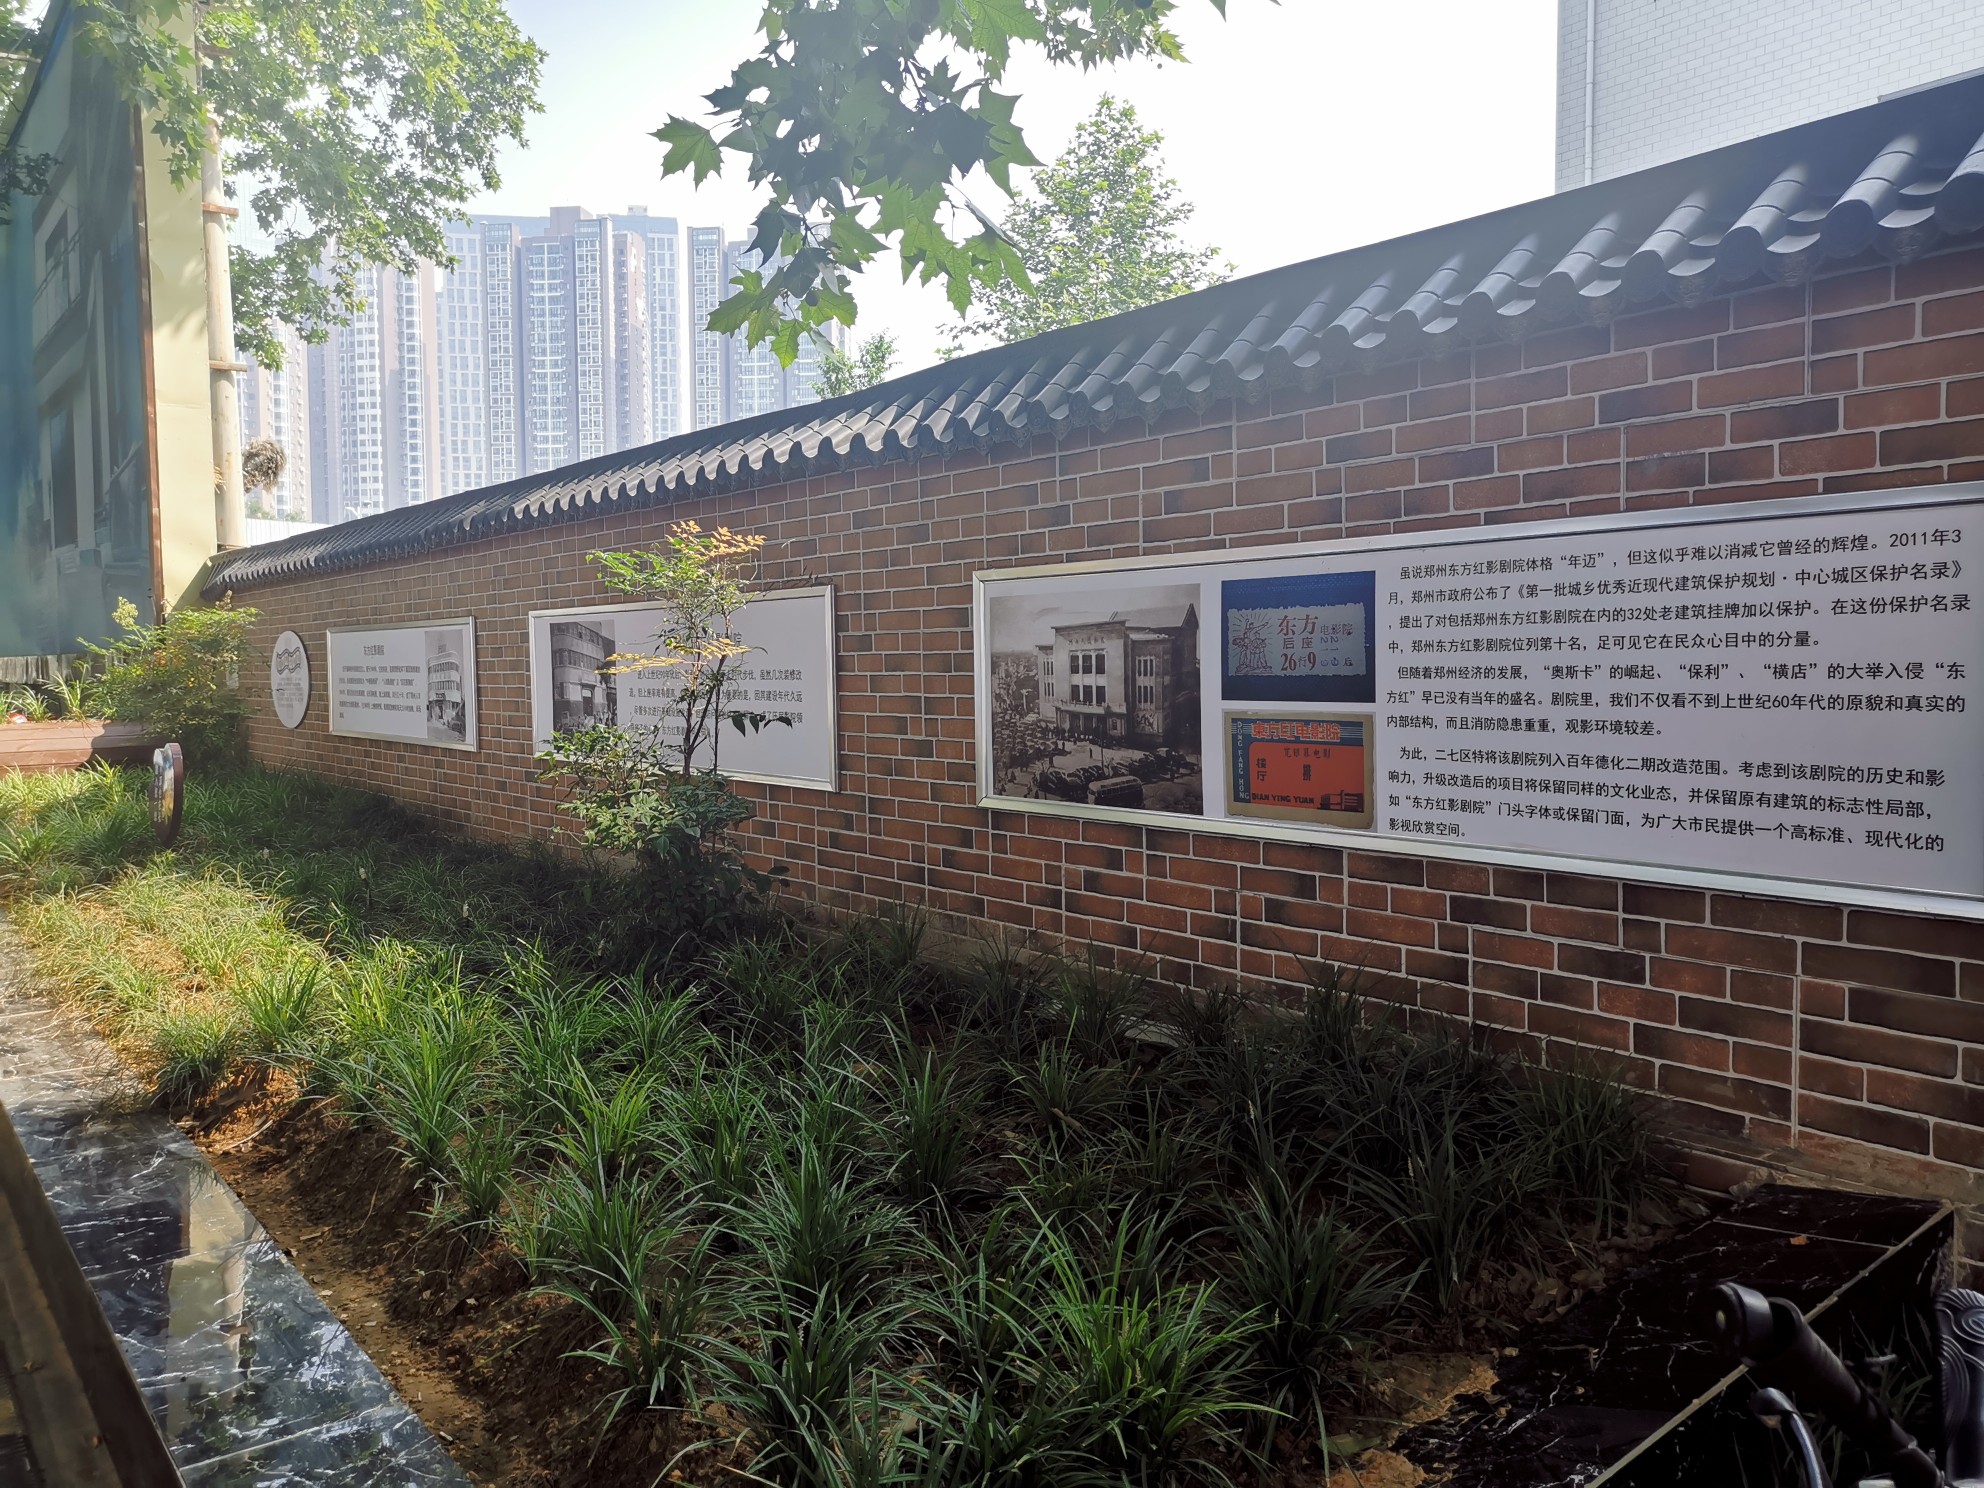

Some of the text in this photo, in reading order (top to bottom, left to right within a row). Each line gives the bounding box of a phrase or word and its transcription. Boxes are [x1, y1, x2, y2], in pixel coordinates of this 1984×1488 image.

[1276, 614, 1354, 636] 东方 电影院
[1251, 792, 1315, 804] DIAN YING YUAN
[1389, 817, 1466, 838] 影视欣赏空间。
